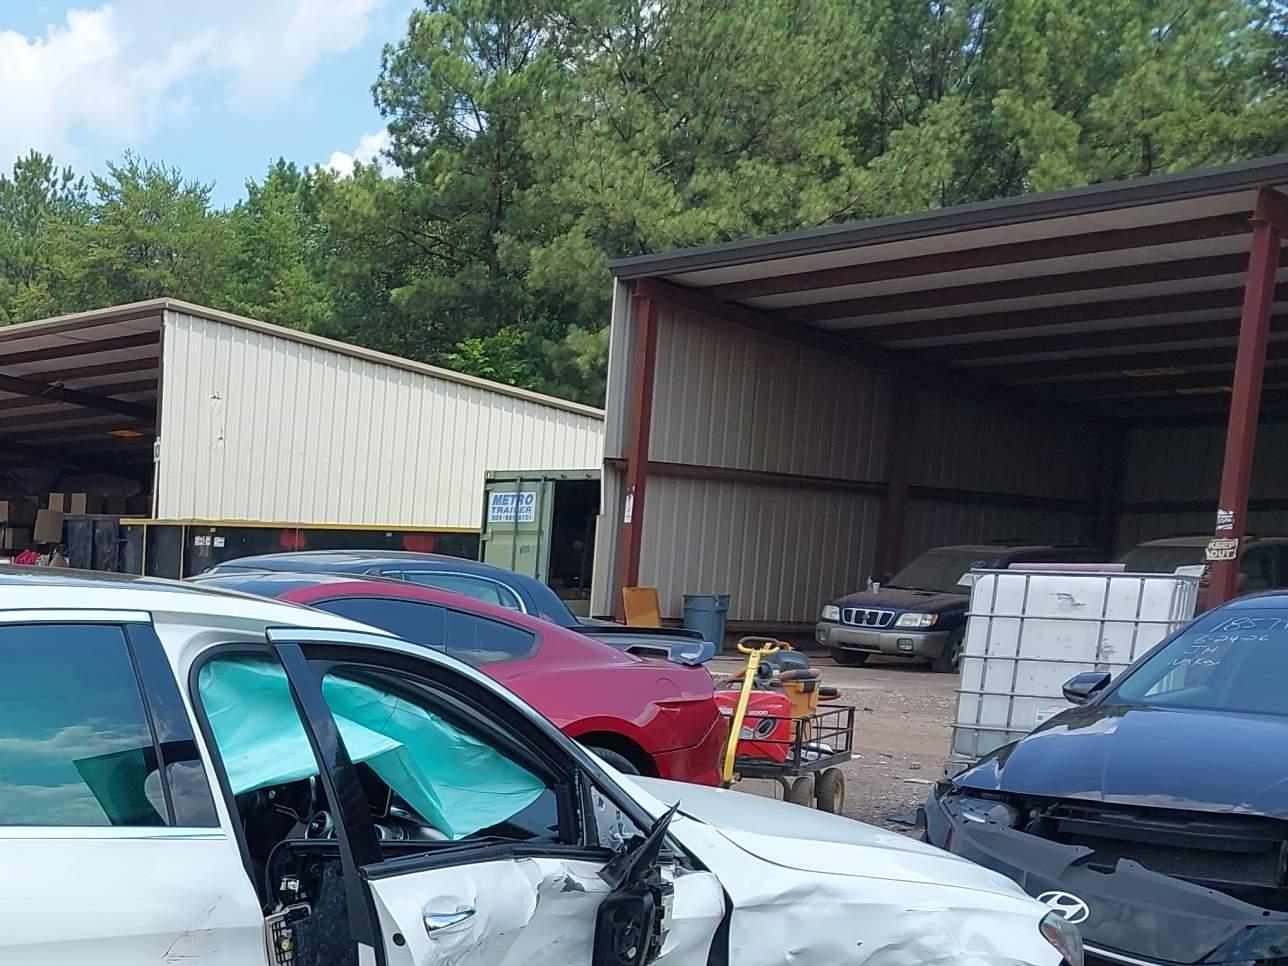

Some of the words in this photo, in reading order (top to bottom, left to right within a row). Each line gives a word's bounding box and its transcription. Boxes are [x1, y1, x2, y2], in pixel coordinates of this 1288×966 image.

[492, 494, 534, 505] METRO
[1208, 541, 1235, 550] KEEP
[1211, 549, 1234, 558] OUT
